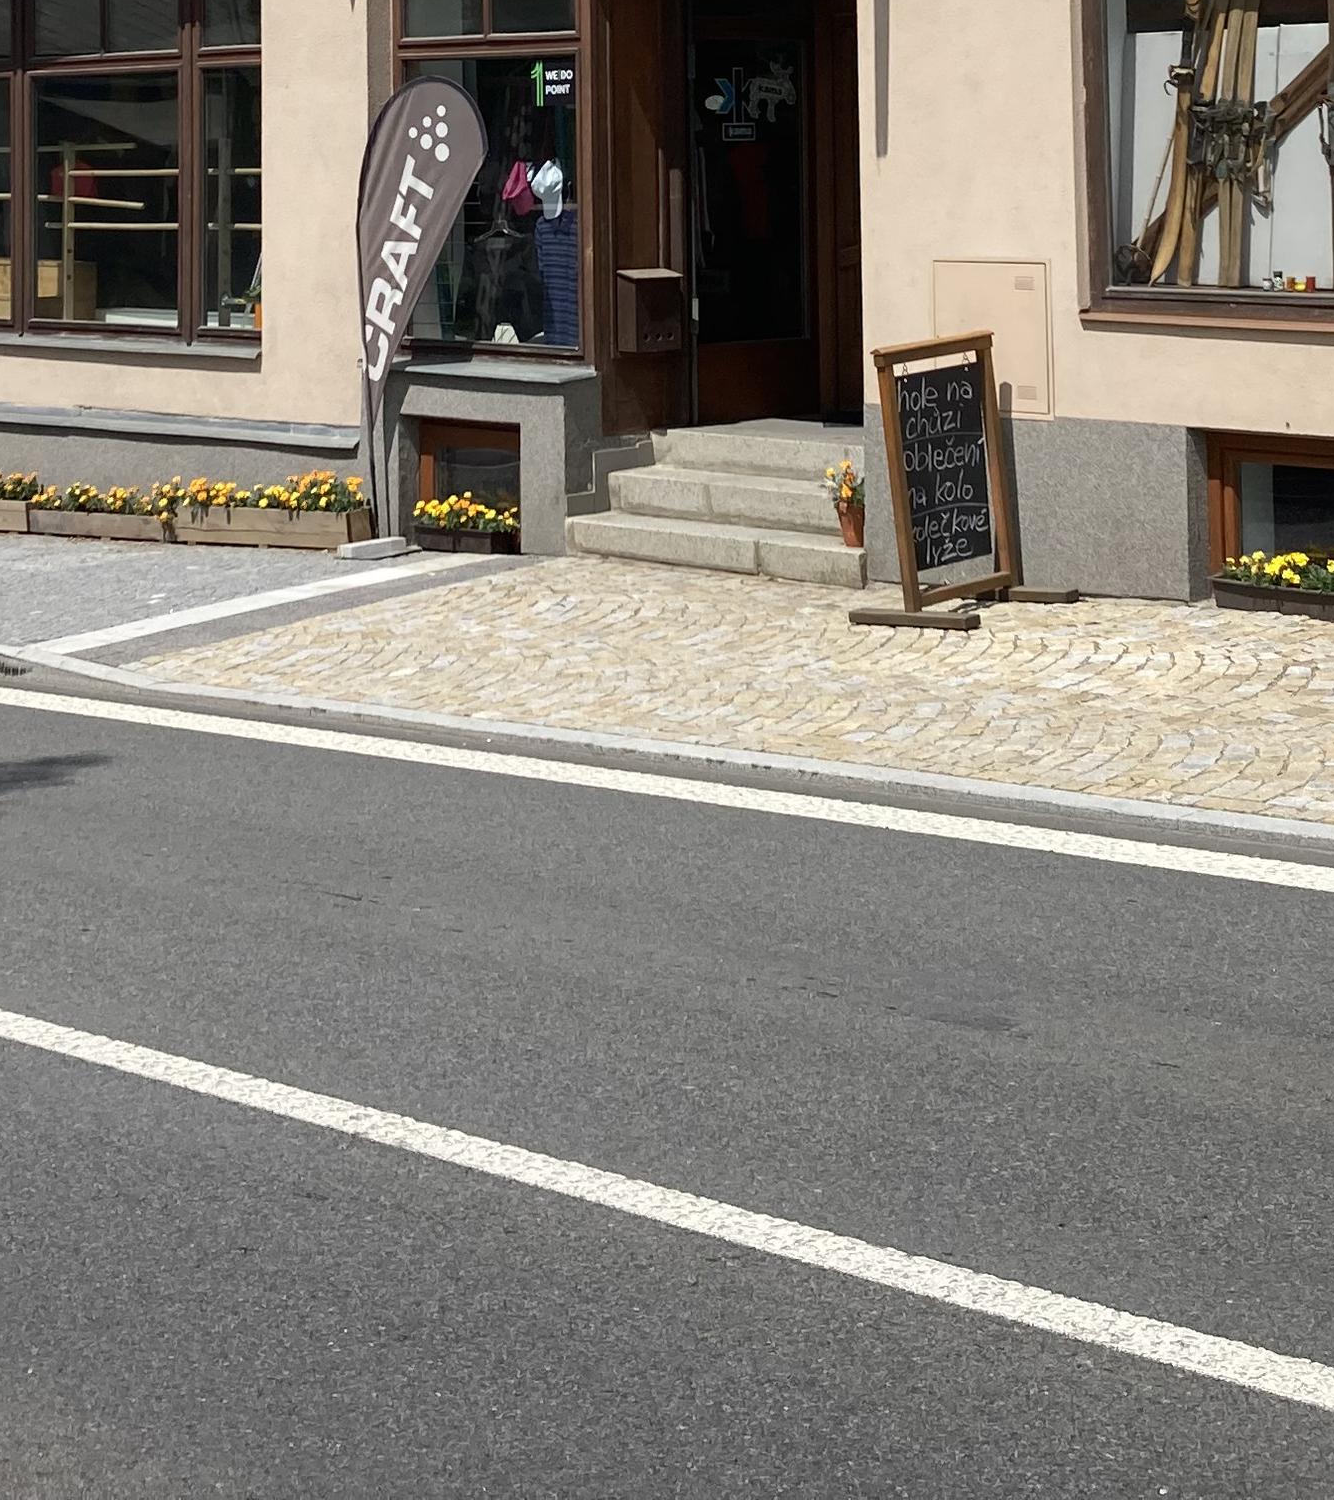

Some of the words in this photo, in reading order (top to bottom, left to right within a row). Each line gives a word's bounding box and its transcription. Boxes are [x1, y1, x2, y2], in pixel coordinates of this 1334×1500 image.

[545, 70, 559, 80] WE
[560, 69, 573, 80] DO
[545, 84, 571, 95] POINT
[365, 154, 434, 382] CRAFT
[897, 376, 938, 412] hole
[947, 380, 973, 402] na
[903, 436, 985, 472] oblečení
[935, 468, 974, 505] kolo
[926, 537, 974, 566] lyže
